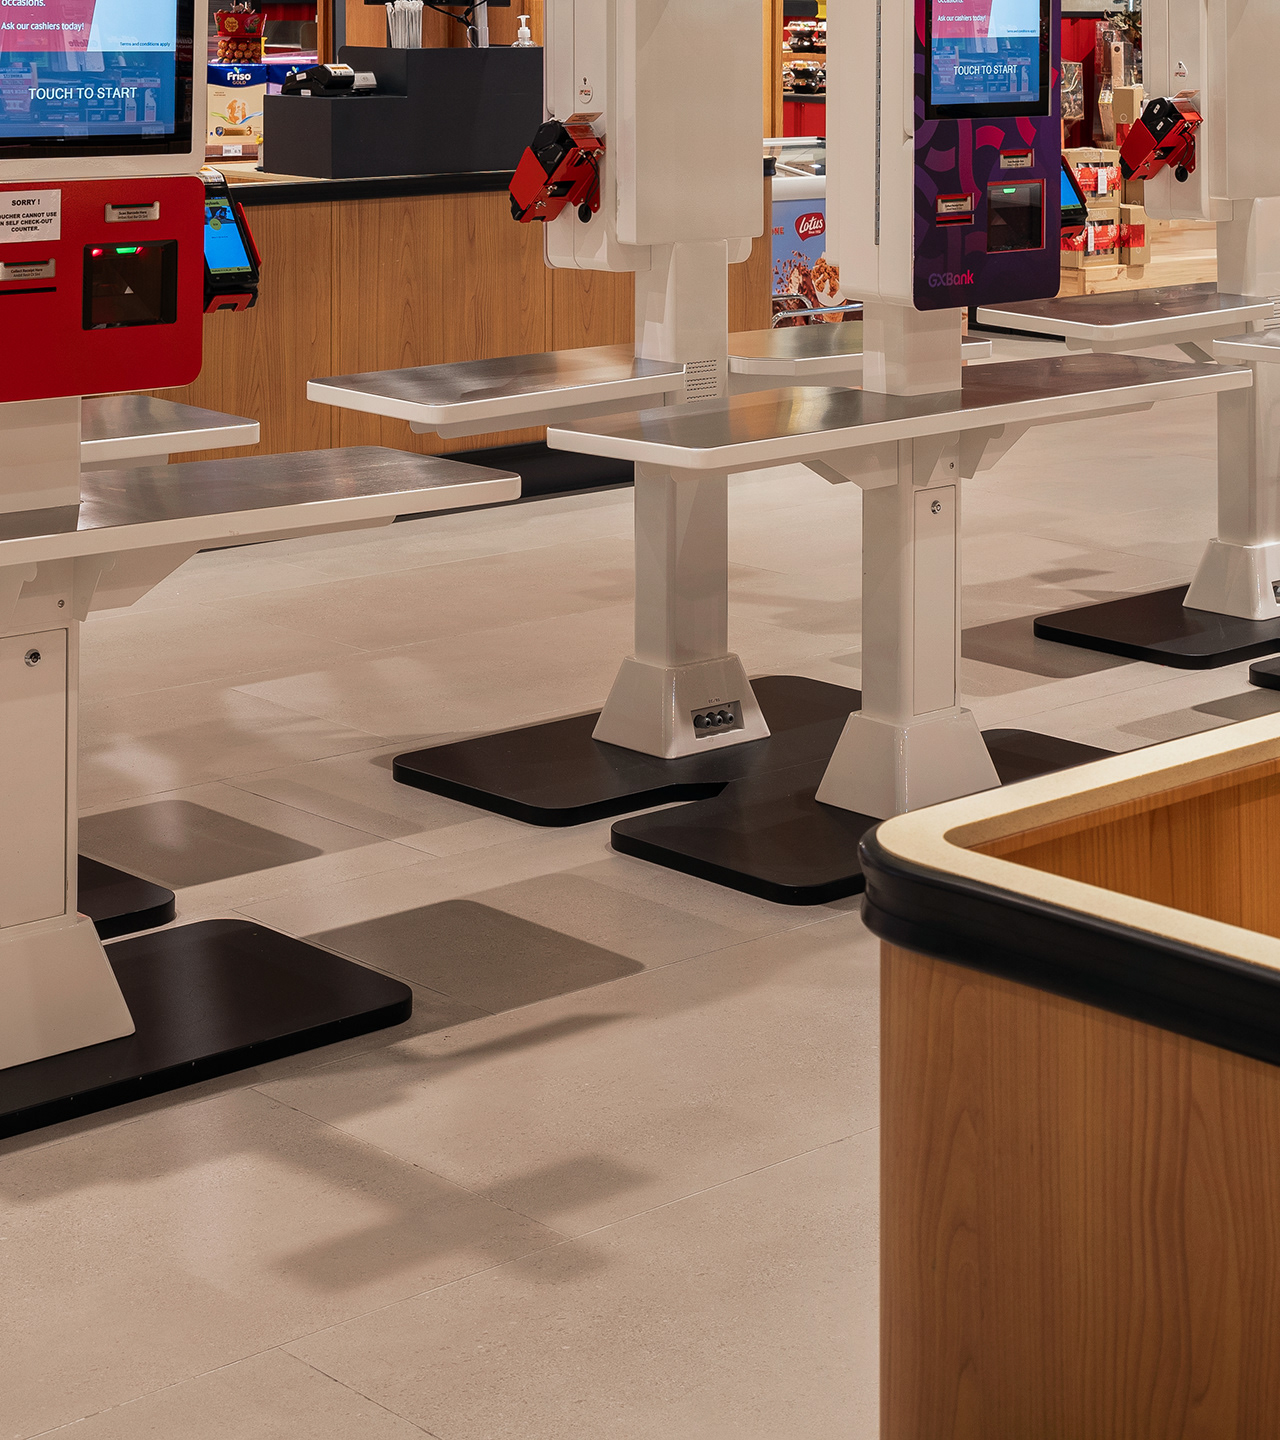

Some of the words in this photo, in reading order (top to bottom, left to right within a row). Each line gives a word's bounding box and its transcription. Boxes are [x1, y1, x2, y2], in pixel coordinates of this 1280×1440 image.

[956, 14, 972, 22] cashiers
[972, 14, 986, 23] today!
[1, 22, 14, 30] Ask
[30, 22, 60, 30] cashiers
[62, 23, 84, 32] today!
[954, 65, 980, 75] TOUCH
[982, 65, 992, 75] TO
[994, 65, 1017, 74] START
[227, 72, 251, 81] Friso
[29, 88, 72, 99] TOUCH
[77, 88, 94, 99] TO
[97, 87, 137, 98] START
[799, 217, 823, 234] Lotus
[928, 269, 974, 288] GXBank
